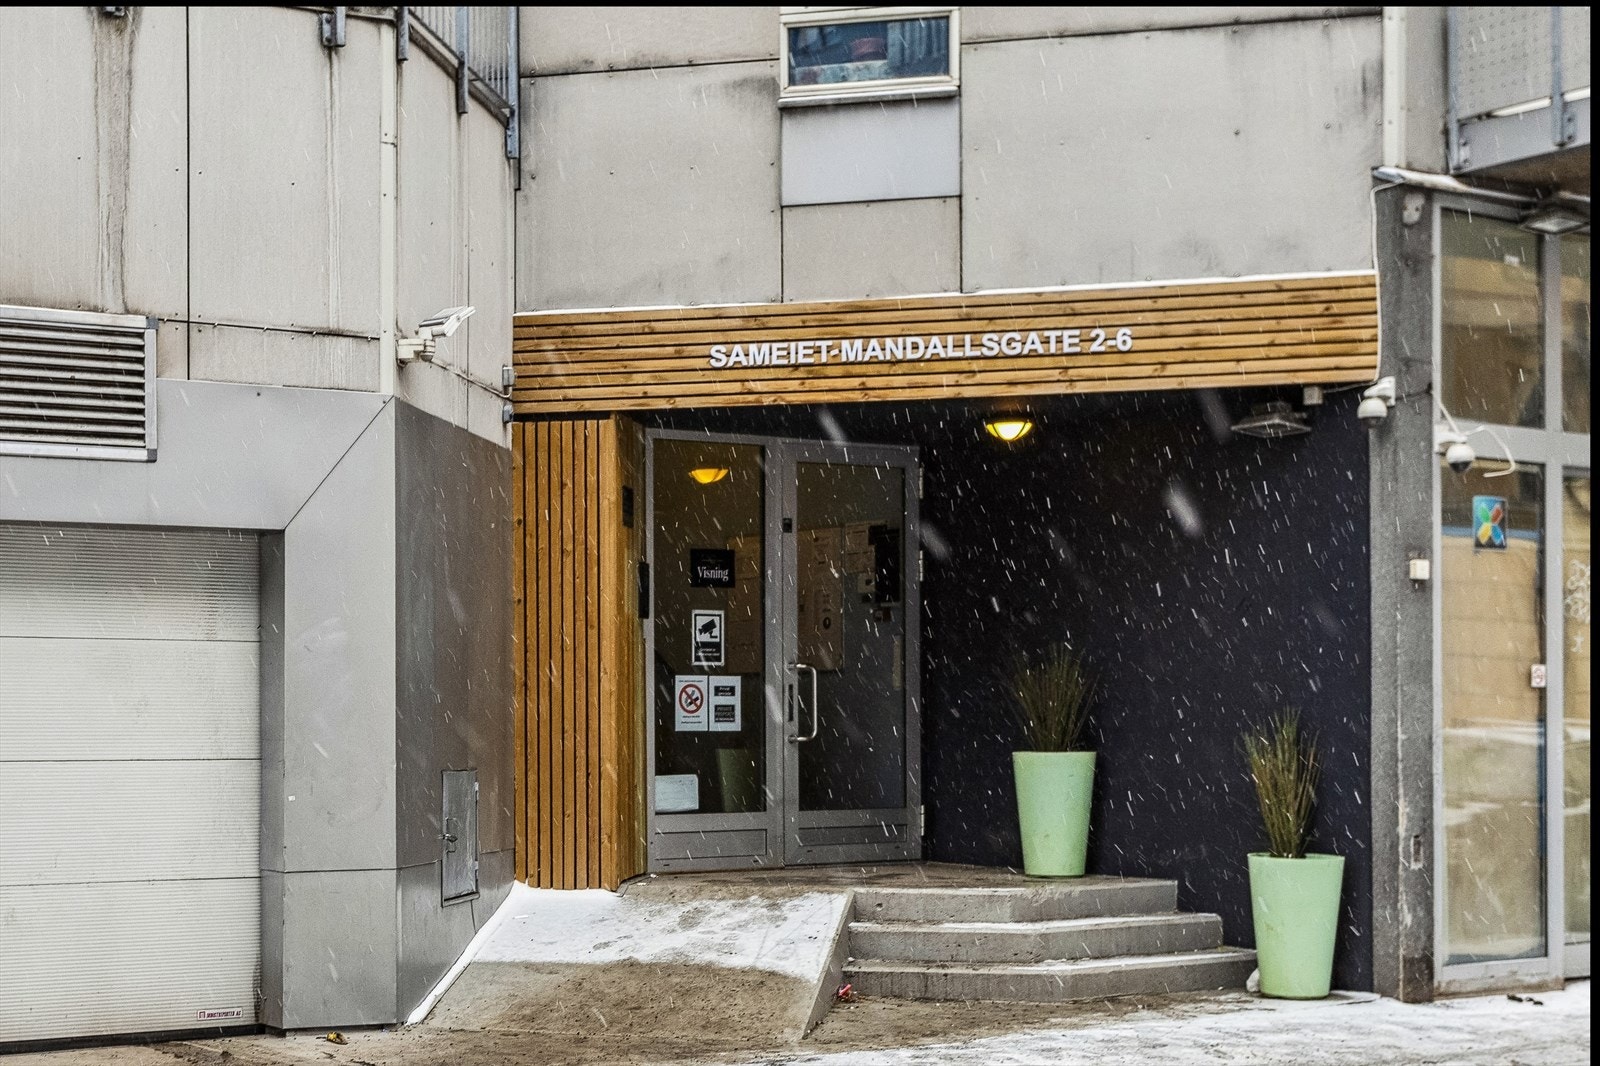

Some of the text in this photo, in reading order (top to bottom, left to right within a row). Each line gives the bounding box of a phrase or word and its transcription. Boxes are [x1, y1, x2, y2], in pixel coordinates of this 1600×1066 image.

[709, 327, 1133, 368] SAMEIET-MANDALLSGATE 2-6
[697, 566, 729, 582] Visning
